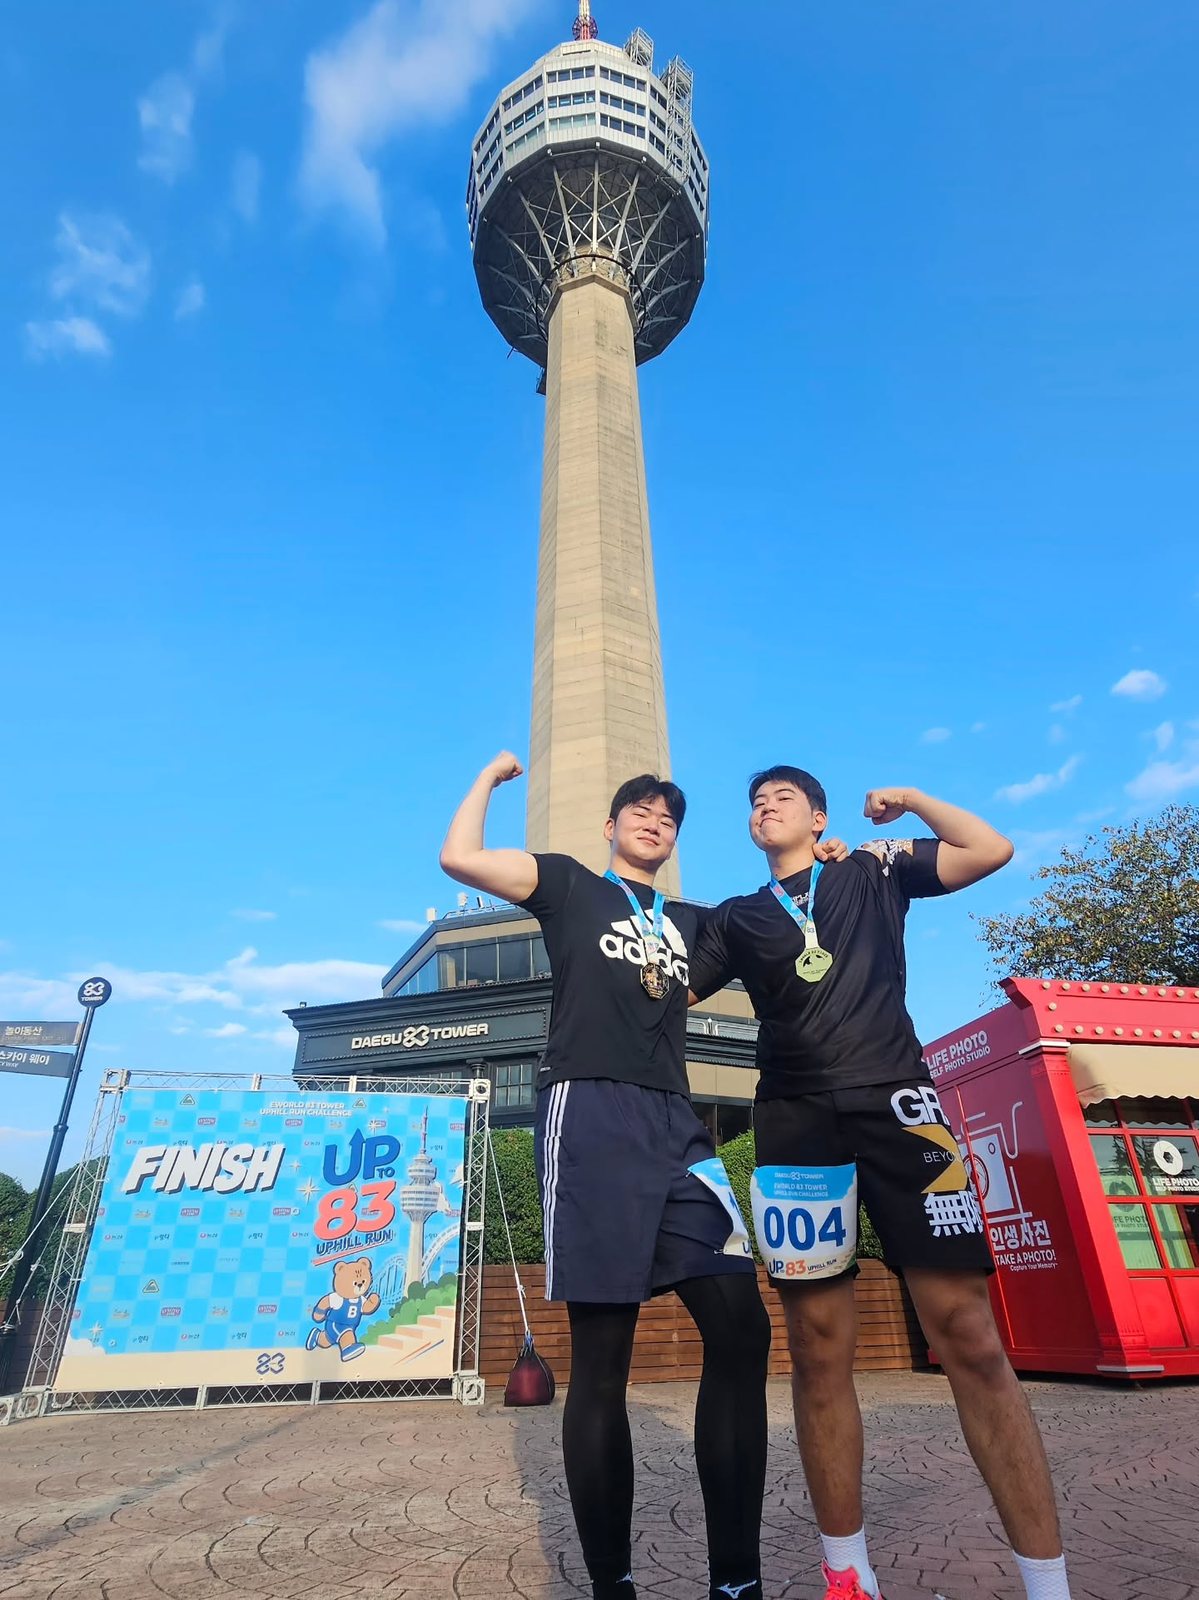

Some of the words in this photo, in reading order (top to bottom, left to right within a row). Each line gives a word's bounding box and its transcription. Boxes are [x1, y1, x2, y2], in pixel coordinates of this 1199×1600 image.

[599, 934, 690, 987] adda
[83, 982, 105, 996] 83
[351, 1032, 402, 1049] DAEGU
[430, 1023, 489, 1041] TOWER
[926, 1048, 949, 1070] LIFE
[949, 1030, 988, 1060] PHOTO
[930, 1066, 944, 1079] SELF
[945, 1059, 966, 1073] PHOTO
[966, 1045, 991, 1063] STUDIO
[891, 1086, 950, 1126] GR
[121, 1142, 287, 1195] FINISH
[323, 1128, 401, 1186] UP
[923, 1151, 957, 1163] BEYO
[378, 1167, 396, 1179] TO
[1152, 1177, 1171, 1186] LIFE
[313, 1180, 397, 1241] 83
[764, 1206, 847, 1251] 004
[989, 1220, 1052, 1251] 인생사진
[316, 1235, 364, 1255] UPHILL
[365, 1229, 393, 1246] RUN
[768, 1257, 784, 1275] UP
[785, 1259, 807, 1277] 83
[808, 1263, 825, 1271] UPHILL
[994, 1253, 1016, 1266] TAKE
[1016, 1252, 1023, 1264] A
[1023, 1249, 1057, 1264] PHOTO!
[347, 1306, 358, 1319] B
